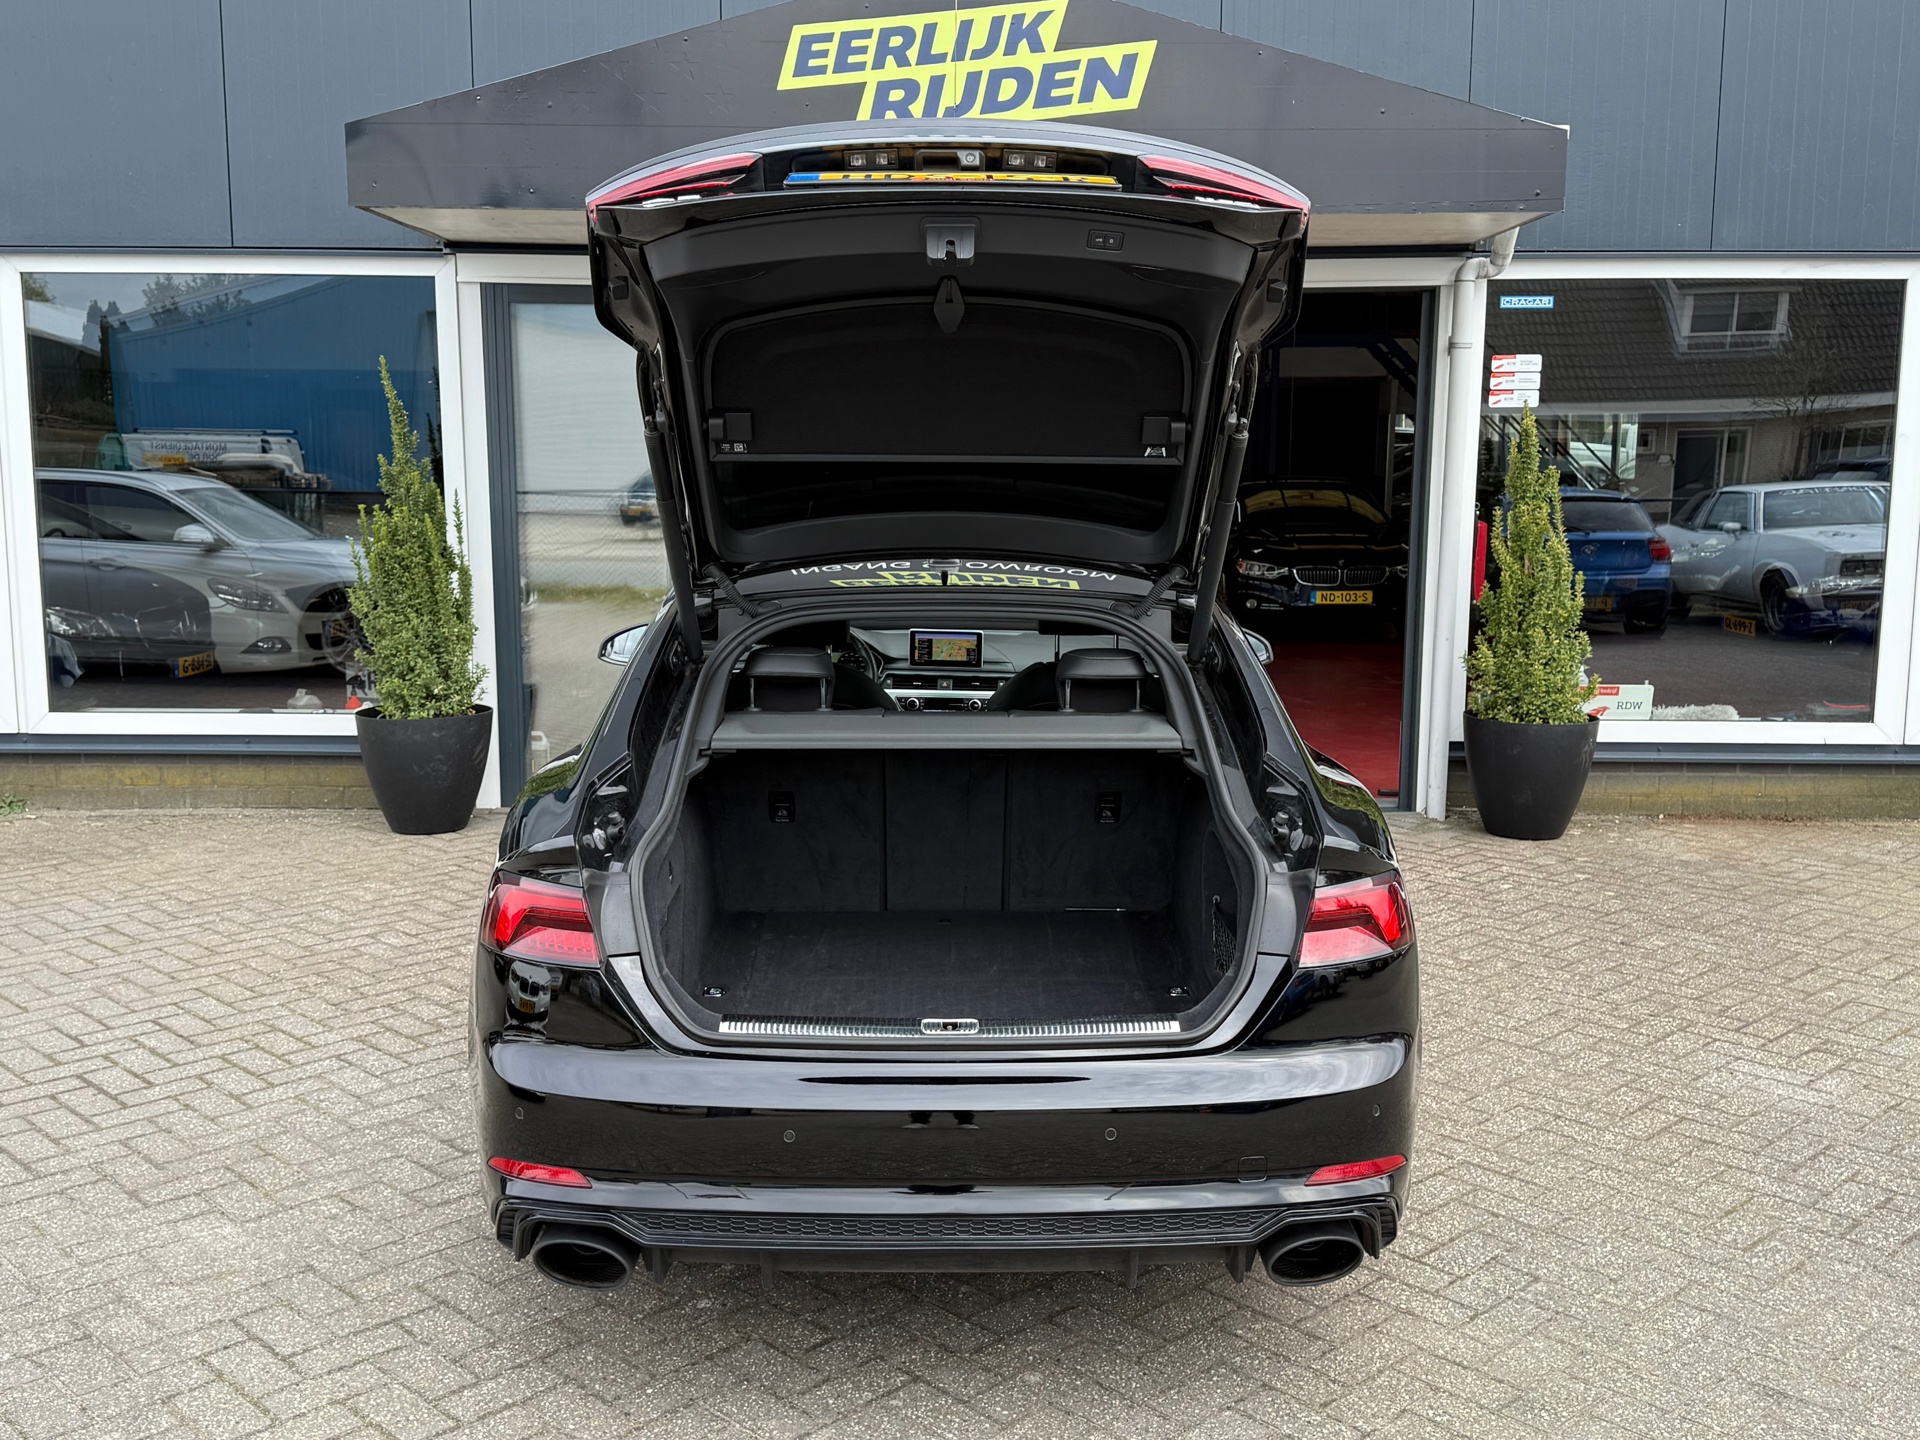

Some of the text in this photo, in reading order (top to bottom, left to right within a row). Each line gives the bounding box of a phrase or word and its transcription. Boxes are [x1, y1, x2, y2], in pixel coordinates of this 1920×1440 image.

[793, 9, 1056, 78] EERLIJK
[869, 53, 1139, 118] RIJDEN
[1320, 592, 1368, 602] ND-103-S
[1600, 687, 1618, 695] bedrijf
[1616, 701, 1643, 710] RDW
